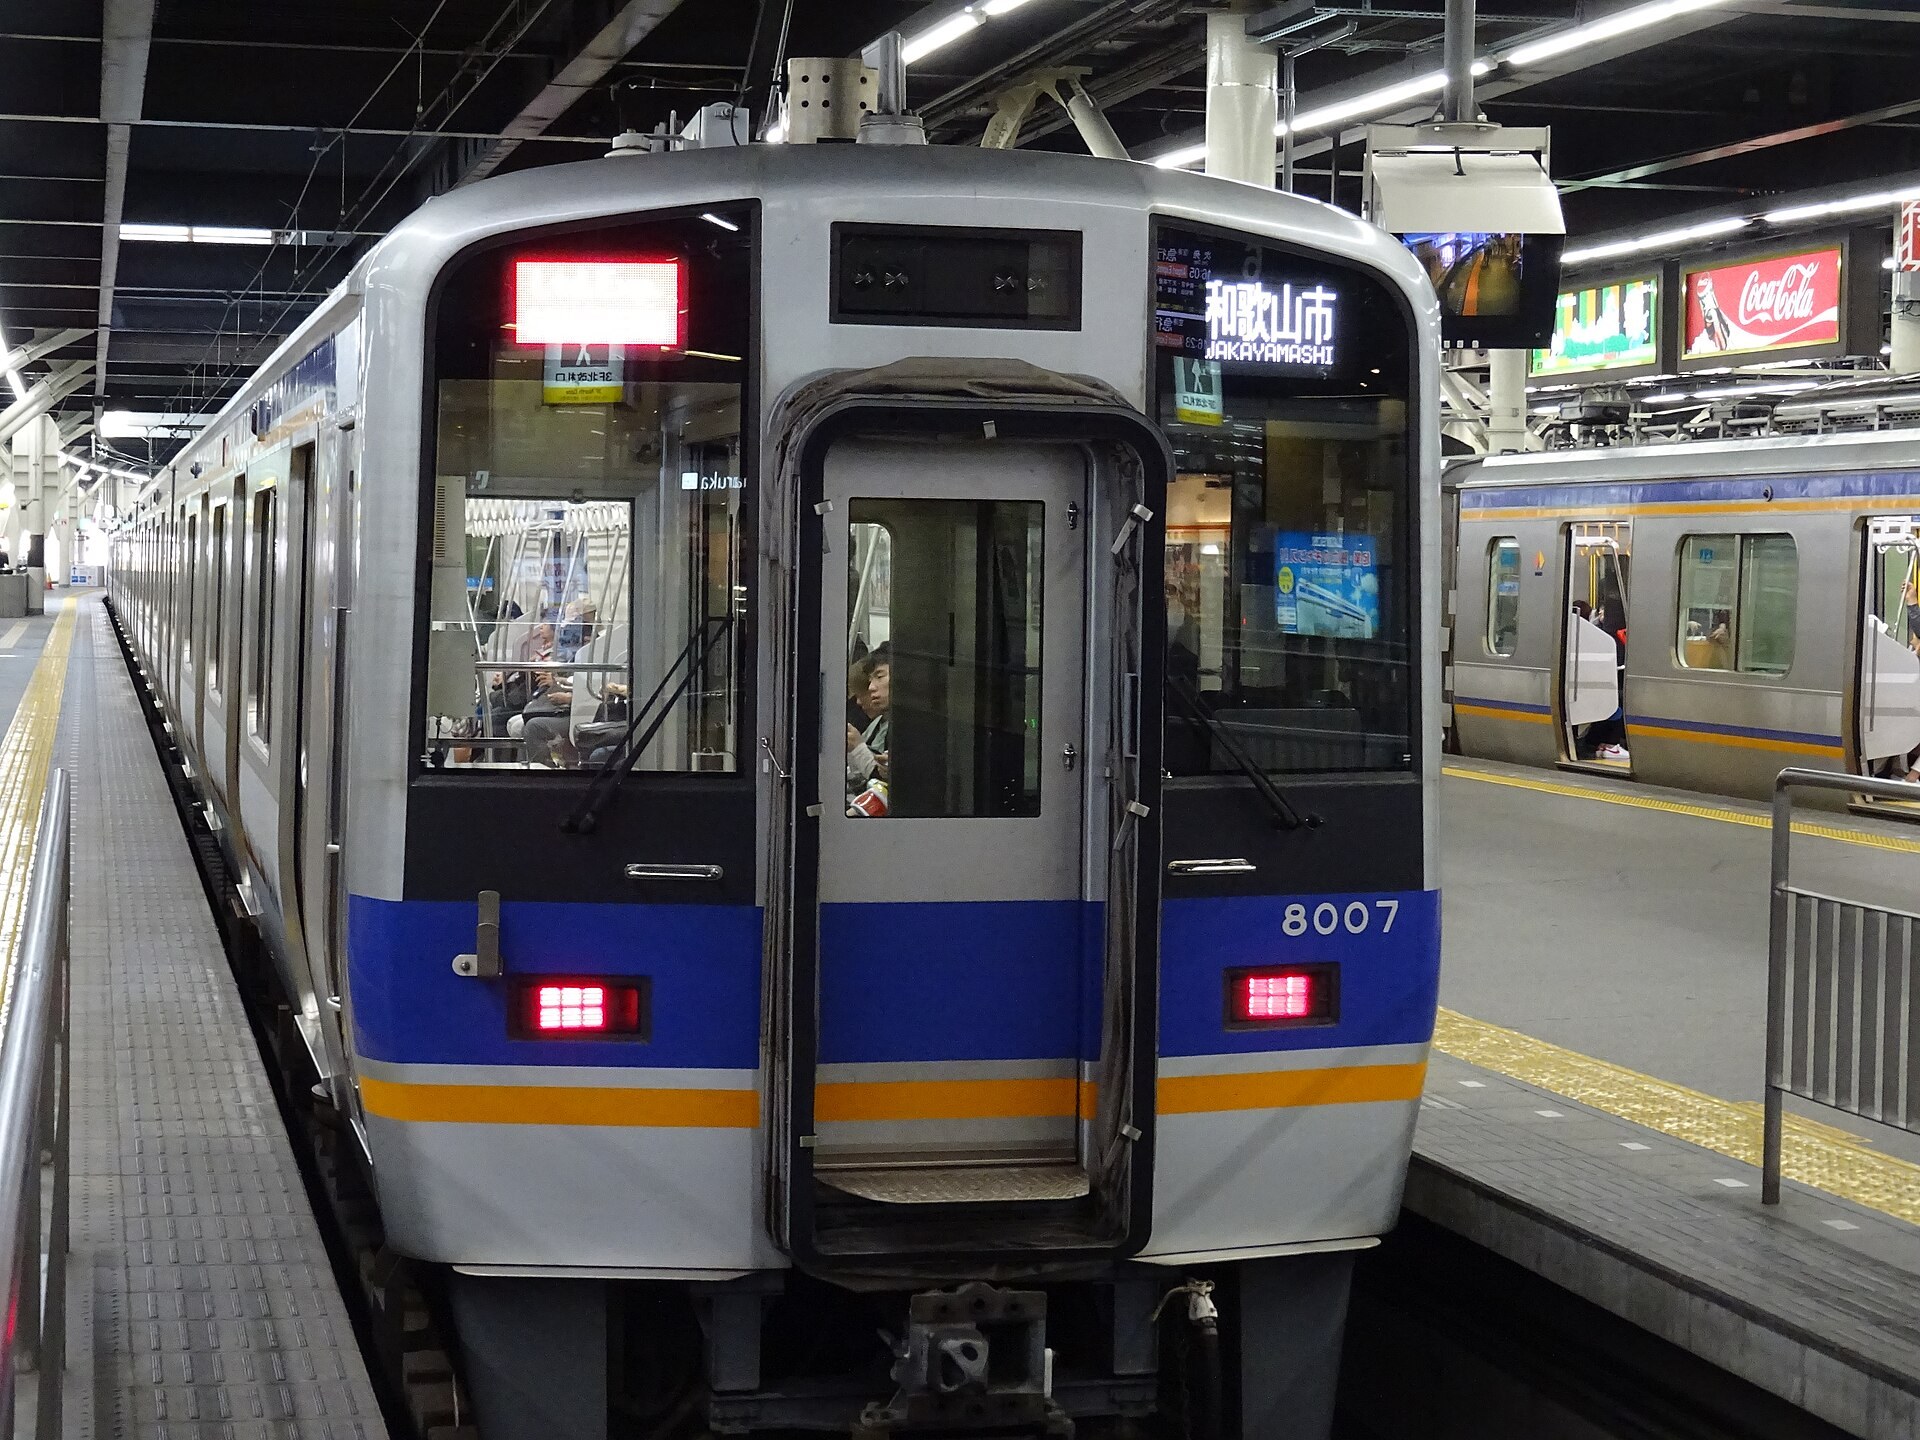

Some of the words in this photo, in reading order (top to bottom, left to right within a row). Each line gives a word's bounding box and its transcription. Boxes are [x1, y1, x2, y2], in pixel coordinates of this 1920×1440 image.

[1205, 279, 1337, 346] 和歌山市
[1739, 261, 1819, 325] Coca-Cola
[1282, 900, 1399, 937] 8007
